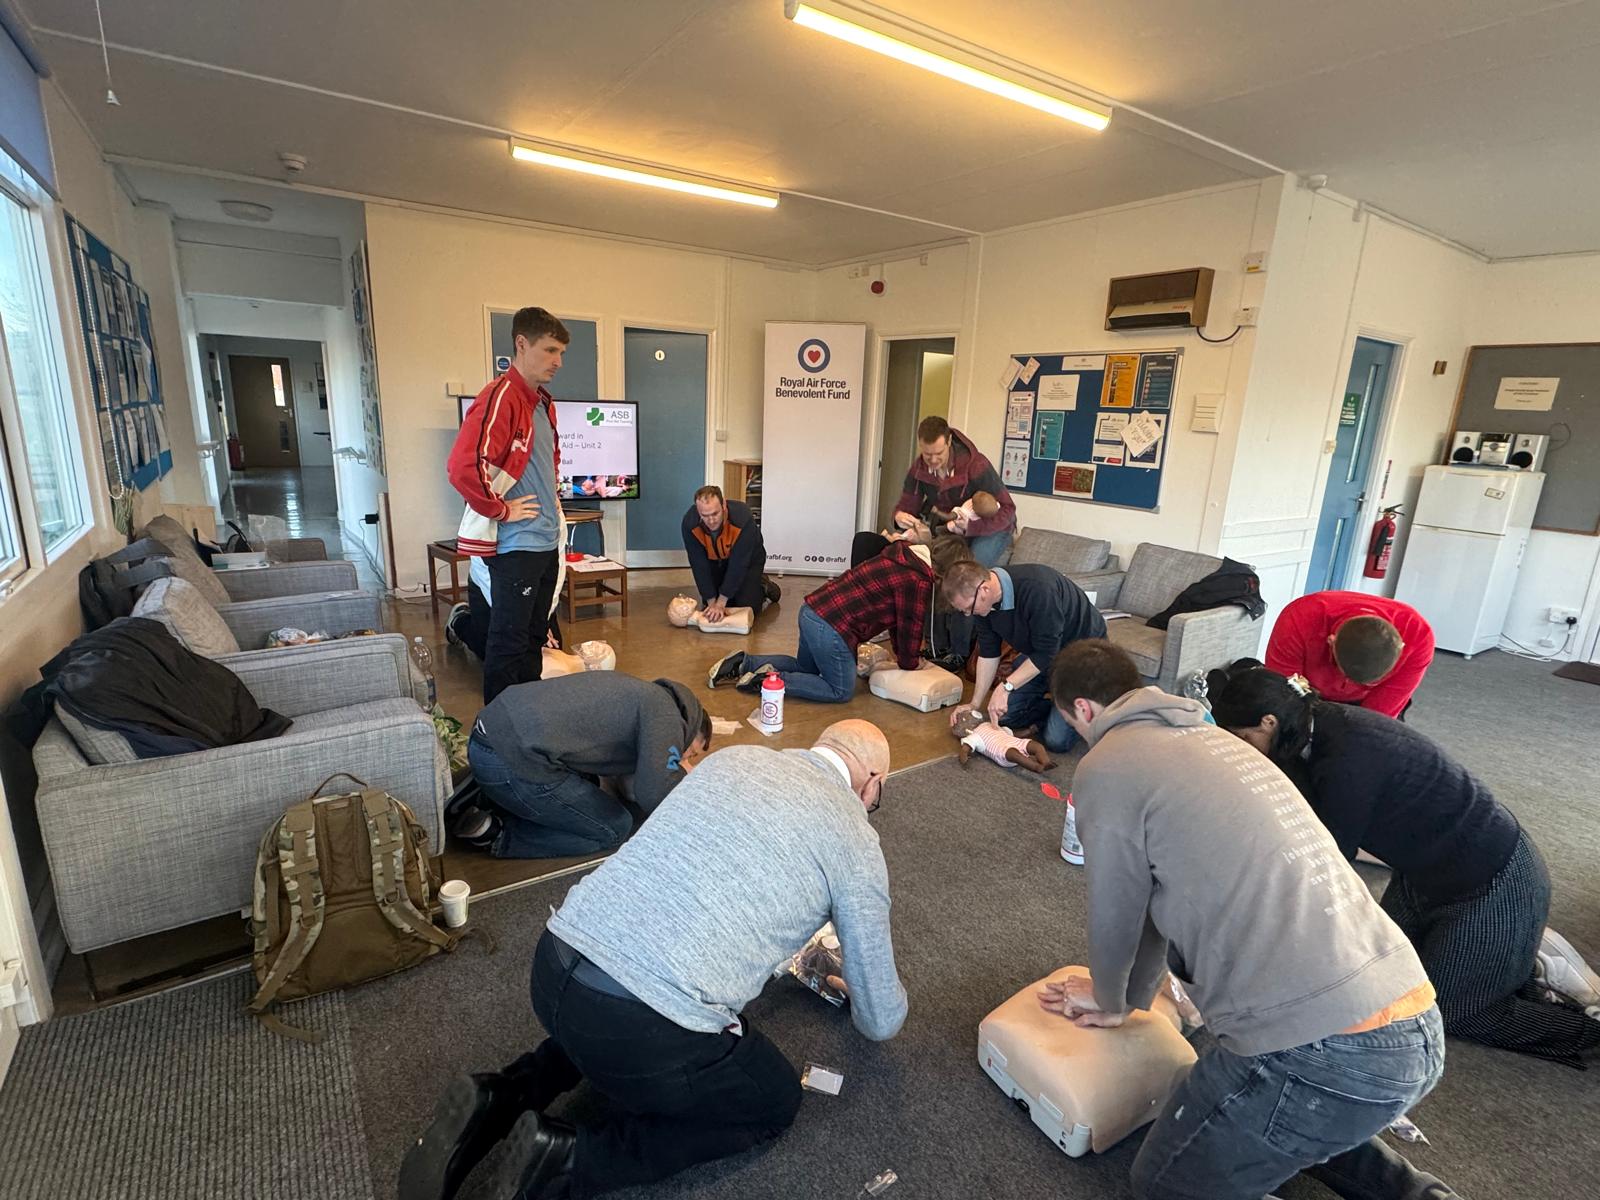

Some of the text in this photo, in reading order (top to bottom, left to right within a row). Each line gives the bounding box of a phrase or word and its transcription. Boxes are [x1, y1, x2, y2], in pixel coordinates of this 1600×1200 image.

[780, 377, 847, 389] Royal Air Force
[775, 388, 851, 400] Benevolent Fund
[610, 410, 630, 419] ASB
[577, 432, 584, 440] in
